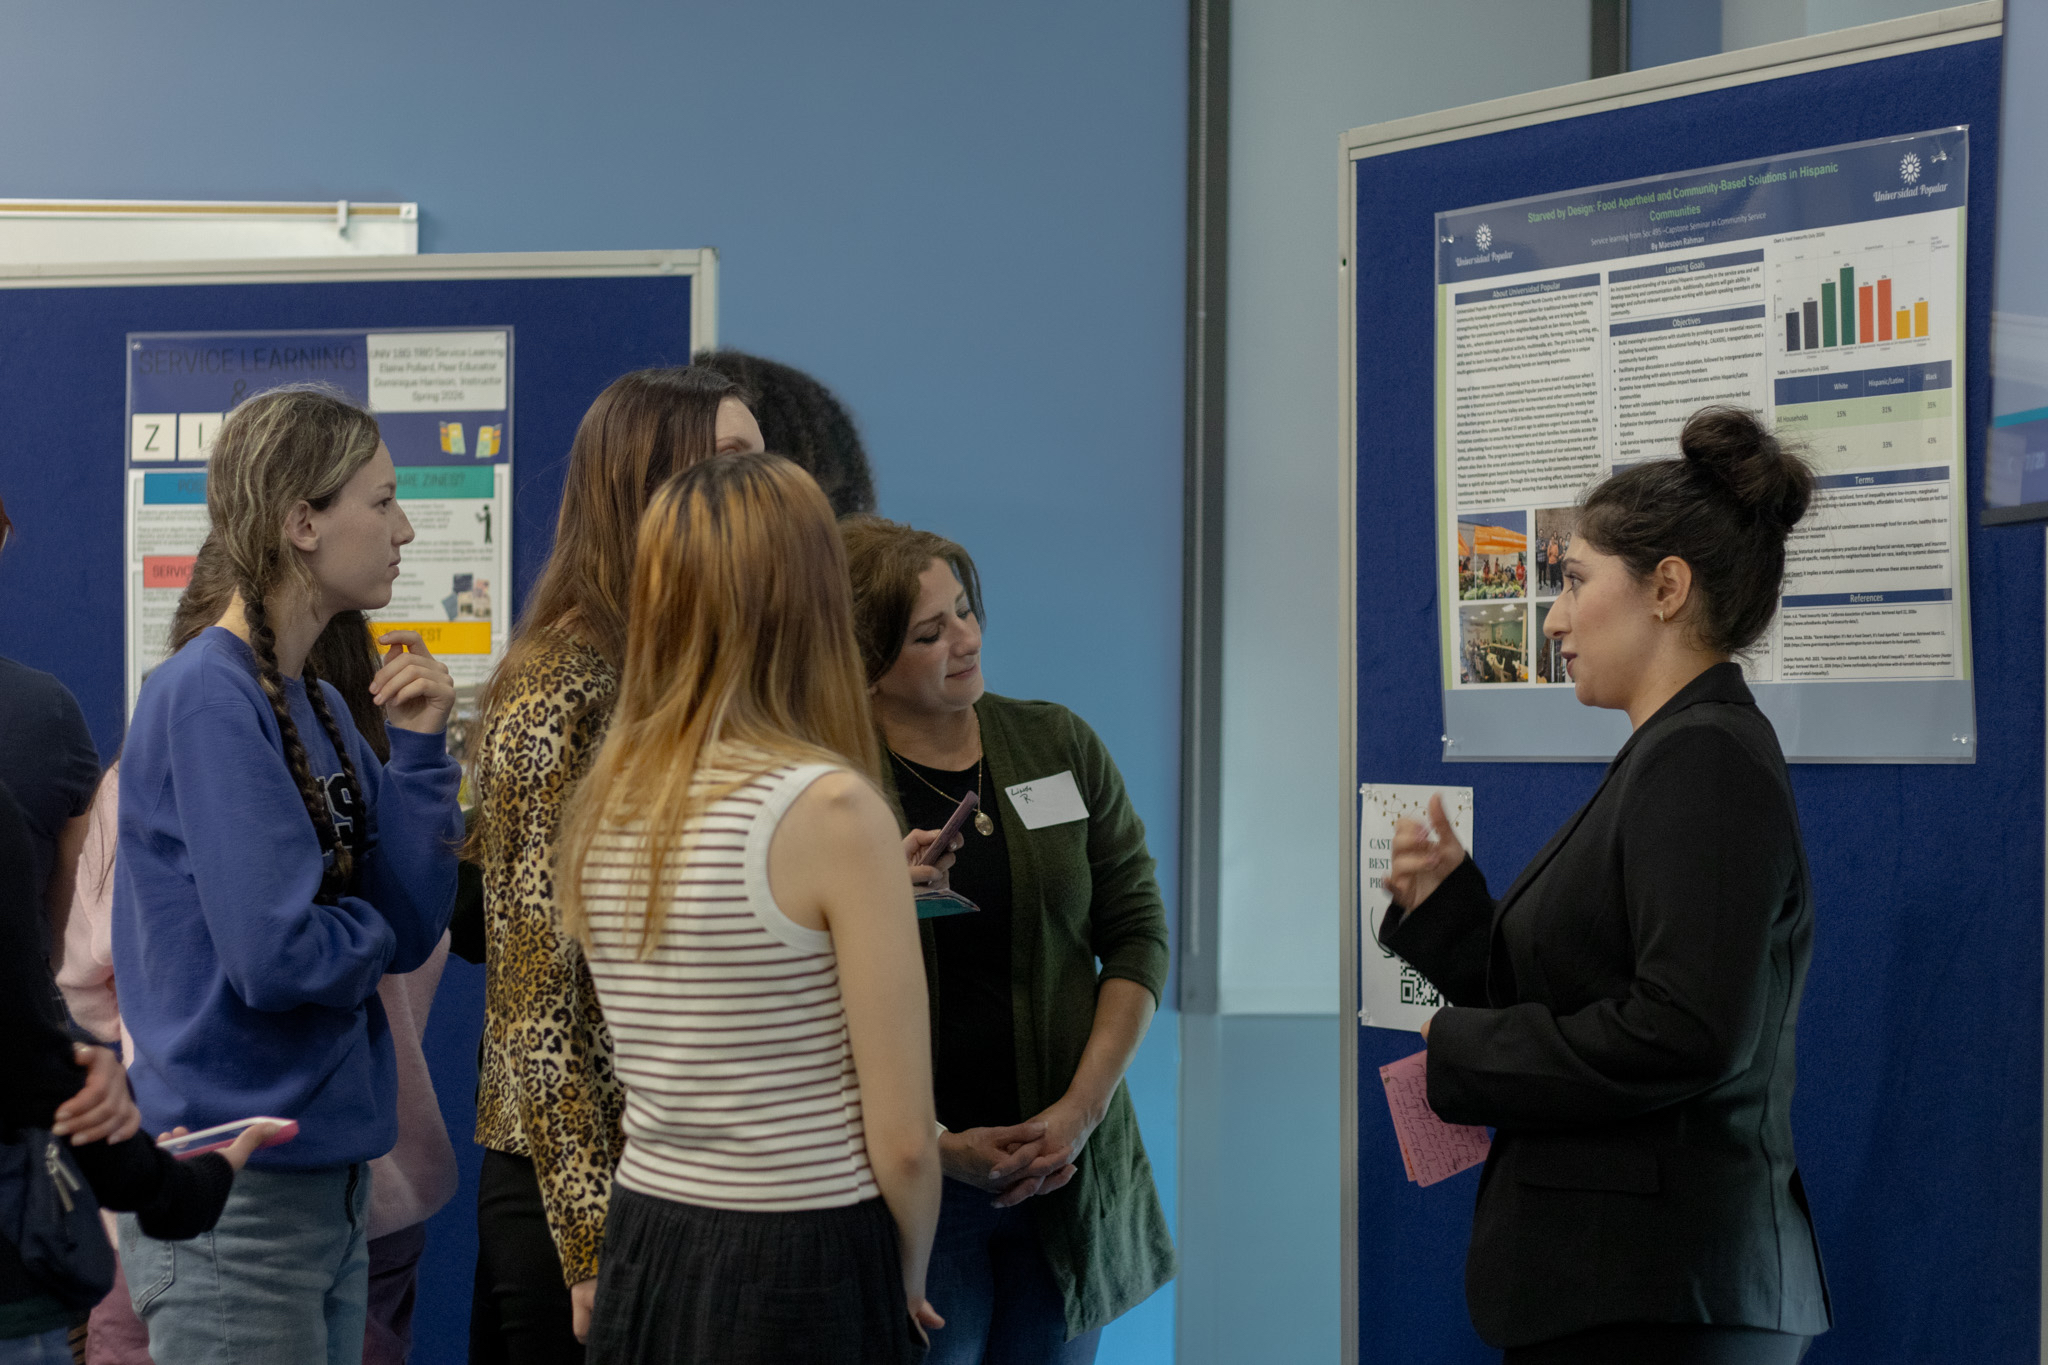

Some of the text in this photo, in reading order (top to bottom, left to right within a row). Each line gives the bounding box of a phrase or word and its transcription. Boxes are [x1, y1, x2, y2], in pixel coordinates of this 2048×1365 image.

[1527, 208, 1556, 223] Starved
[1555, 207, 1566, 220] by
[1566, 203, 1594, 217] Design:
[1596, 197, 1616, 212] Food
[1618, 191, 1655, 210] Apartheid
[1657, 188, 1671, 202] and
[1673, 175, 1746, 199] Community-Based
[1748, 171, 1786, 186] Solutions
[1799, 160, 1838, 178] Hispanic
[1872, 181, 1948, 202] Universidad Popular
[1649, 203, 1701, 221] Communities
[1590, 237, 1608, 246] Service
[1608, 233, 1629, 243] learning
[1628, 232, 1641, 240] from
[1641, 230, 1650, 238] Soc
[1689, 221, 1709, 230] Seminar
[1717, 214, 1747, 226] Community
[1747, 211, 1766, 221] Service
[1682, 236, 1704, 245] Rahman
[1455, 249, 1513, 266] Universidad Popular
[1665, 260, 1705, 273] Learning Goals
[1492, 281, 1560, 298] About Universidad Popular
[1672, 316, 1701, 328] Objectives
[139, 345, 357, 375] SERVICE LEARNING
[1925, 372, 1937, 380] Black
[1833, 382, 1848, 390] White
[1836, 409, 1846, 417] 15%
[1881, 405, 1892, 413] 31%
[1782, 413, 1808, 423] Households
[1837, 444, 1847, 452] 19%
[1882, 440, 1892, 448] 33%
[1854, 475, 1874, 485] Terms
[1849, 594, 1883, 602] References
[1369, 838, 1391, 850] CAST
[1369, 857, 1390, 870] BEST
